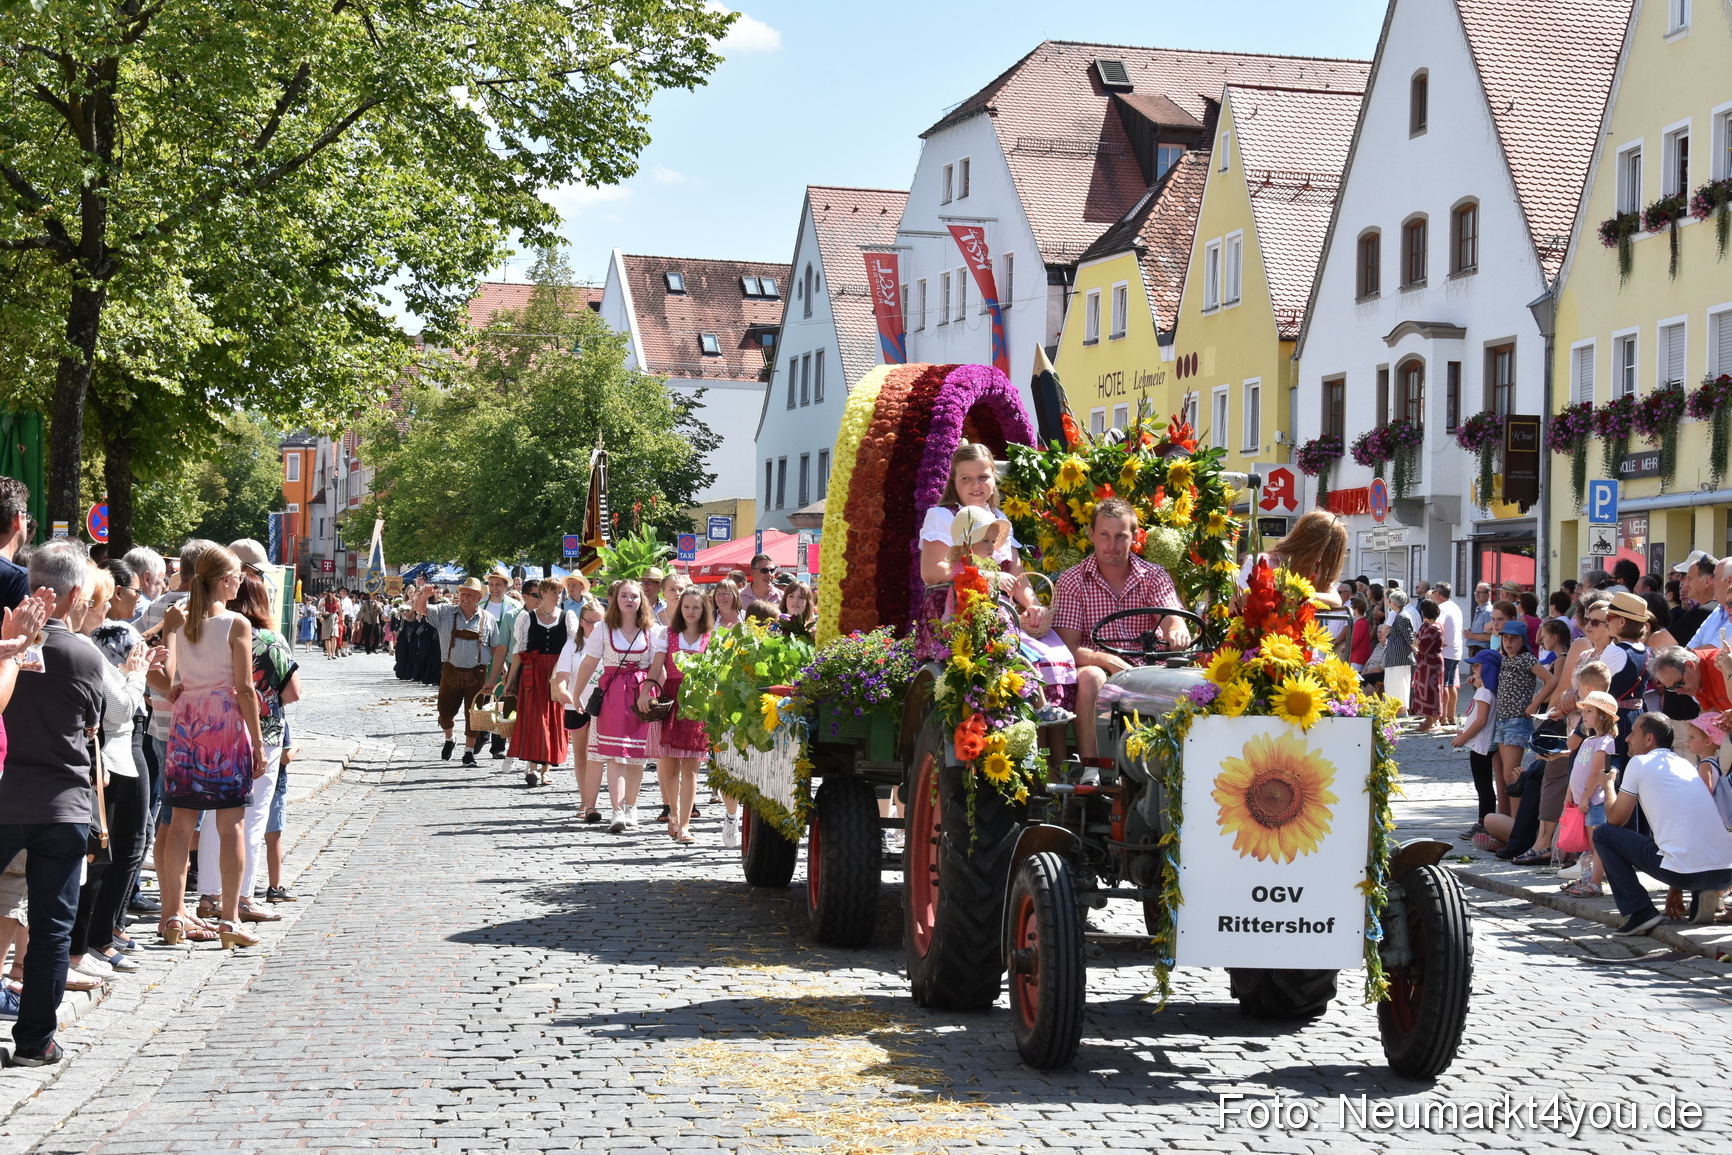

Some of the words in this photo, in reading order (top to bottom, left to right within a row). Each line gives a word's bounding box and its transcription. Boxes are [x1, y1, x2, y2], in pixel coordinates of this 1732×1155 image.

[876, 258, 896, 308] K&L
[1098, 370, 1126, 399] HOTEL
[1133, 366, 1166, 390] Lehmeier
[1641, 457, 1658, 471] MEHR
[1595, 485, 1612, 518] P
[323, 561, 332, 571] T
[1251, 885, 1304, 903] OGV
[1218, 915, 1336, 934] Rittershof
